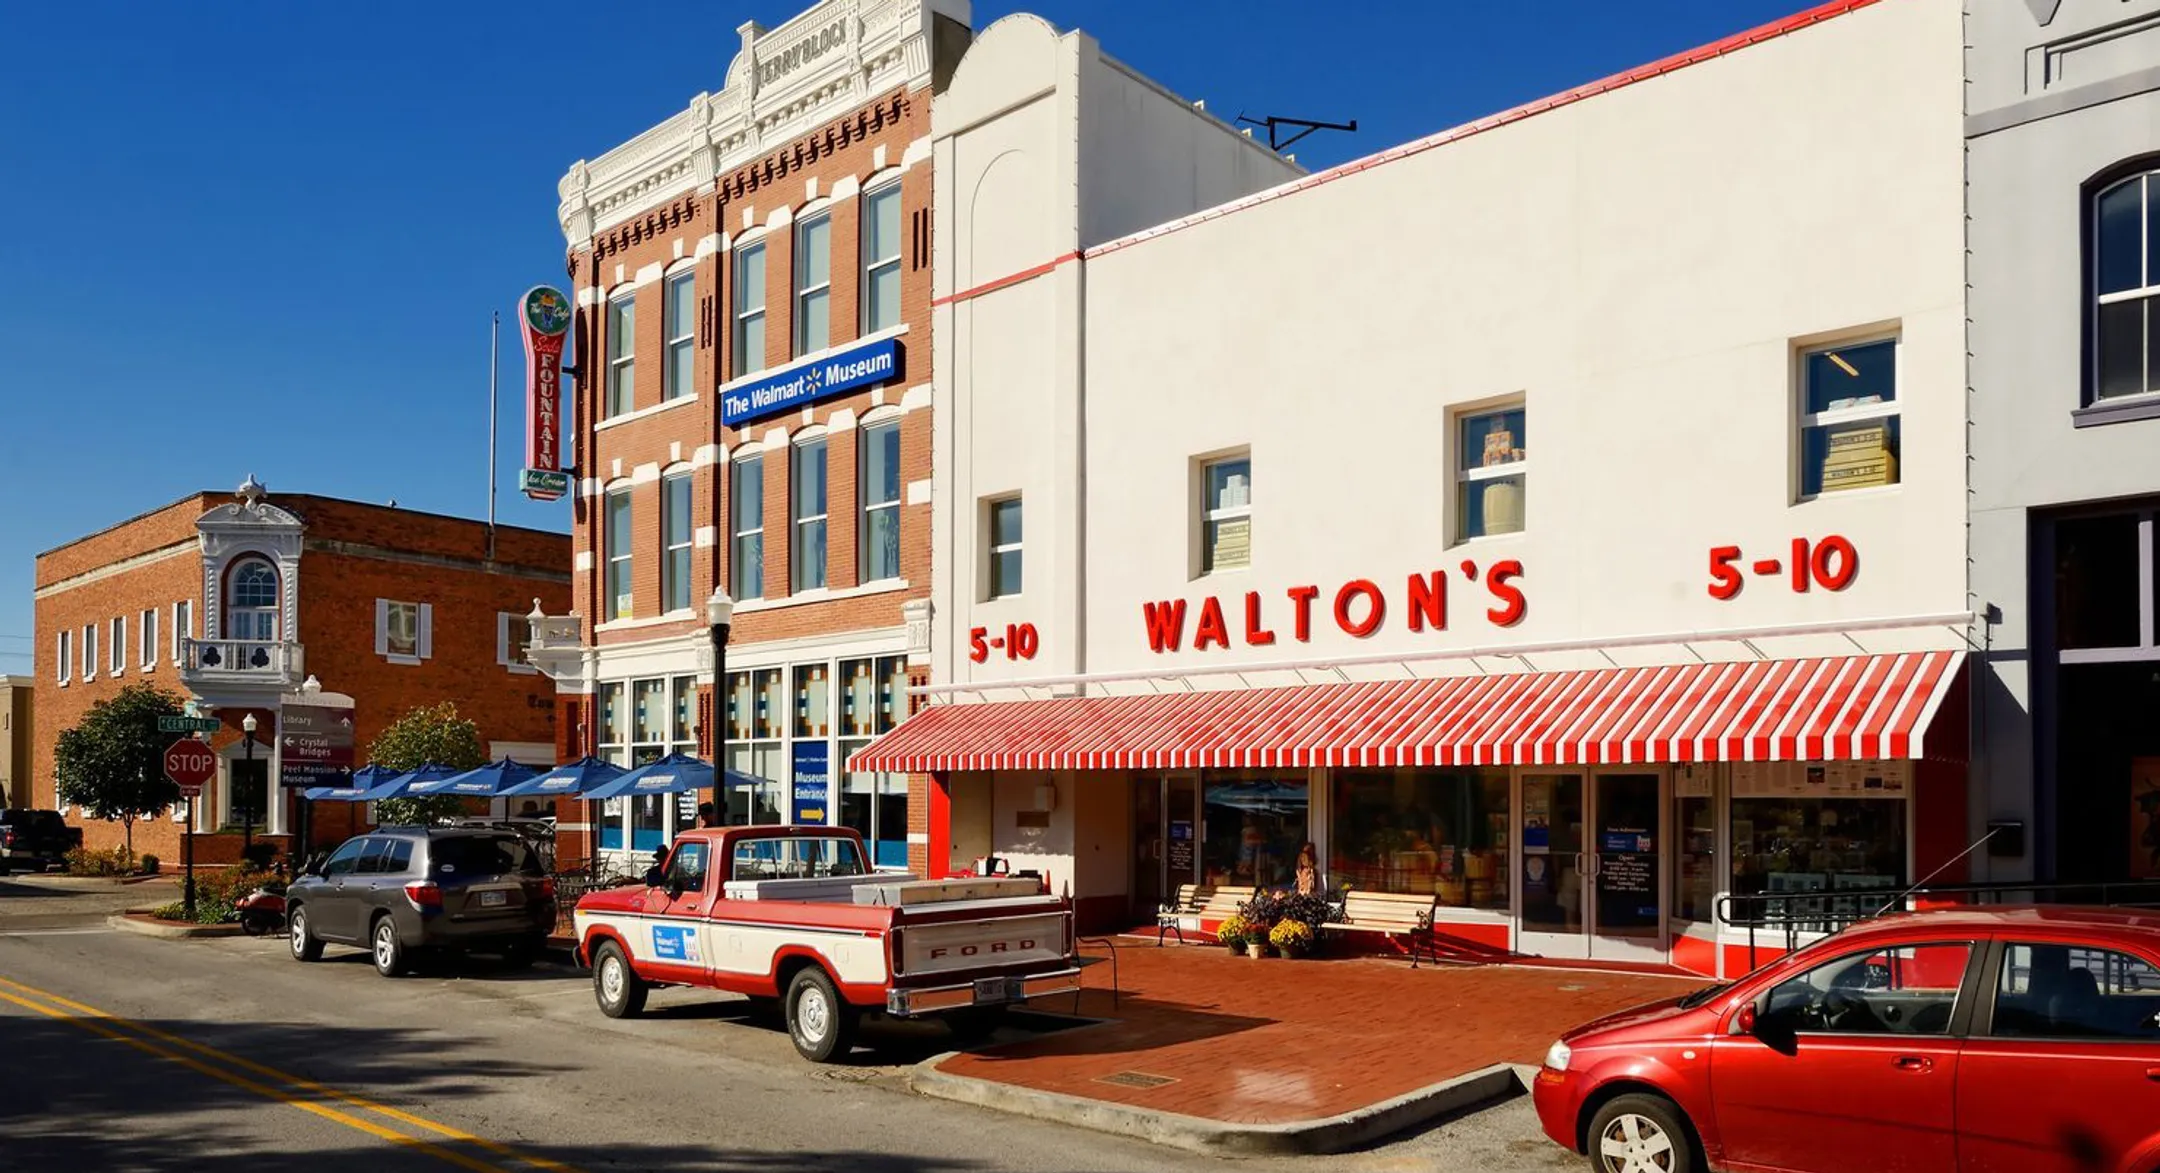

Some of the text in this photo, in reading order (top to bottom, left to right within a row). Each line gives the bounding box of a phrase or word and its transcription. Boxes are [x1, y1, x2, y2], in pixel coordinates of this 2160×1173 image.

[802, 17, 846, 64] BLOCK
[725, 352, 892, 417] The Walmart Museum
[540, 354, 554, 468] FOUNTAIN
[1708, 535, 1860, 601] 5-10
[1143, 559, 1528, 653] WALTON'S
[970, 622, 1039, 664] 5-10
[166, 717, 207, 730] CENTRAL
[283, 715, 312, 726] Library
[299, 738, 329, 749] Crystal
[168, 754, 213, 772] STOP
[299, 747, 331, 760] Bridges
[283, 775, 317, 783] Museum
[304, 765, 337, 775] Mansion
[931, 939, 1036, 960] FORD
